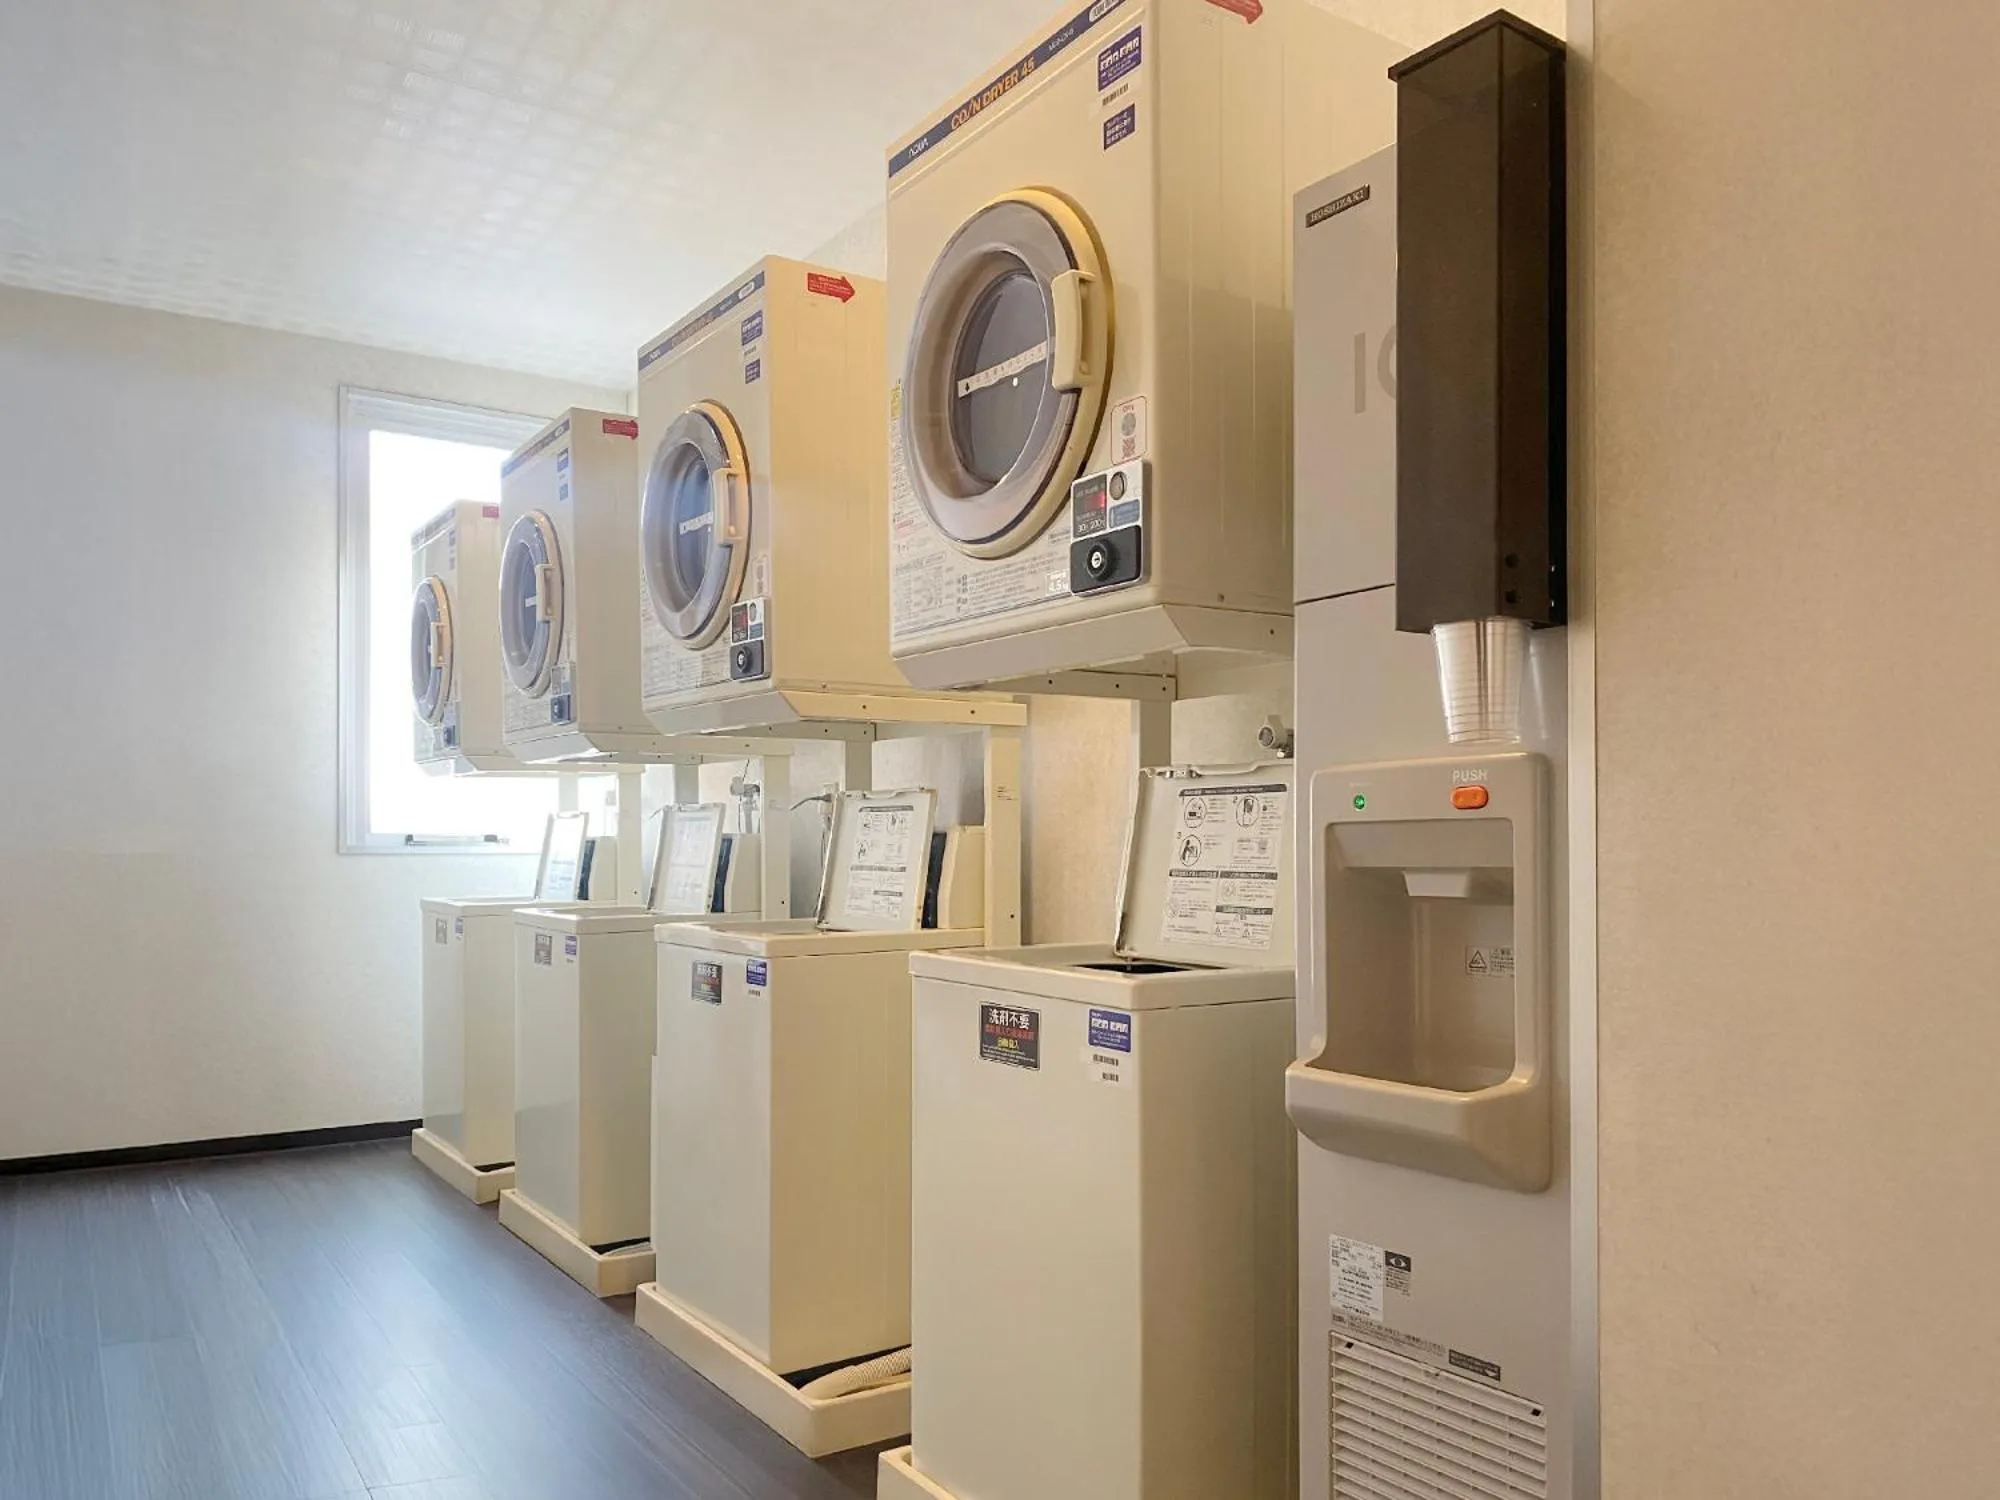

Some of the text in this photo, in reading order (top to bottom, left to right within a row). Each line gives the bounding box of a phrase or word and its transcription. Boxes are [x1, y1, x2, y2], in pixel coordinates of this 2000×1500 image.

[951, 56, 1035, 131] COIN DRYER 45
[1311, 190, 1364, 222] HOSHIZAKI
[1452, 769, 1488, 782] PUSH
[989, 1008, 1030, 1030] 洗剤不要
